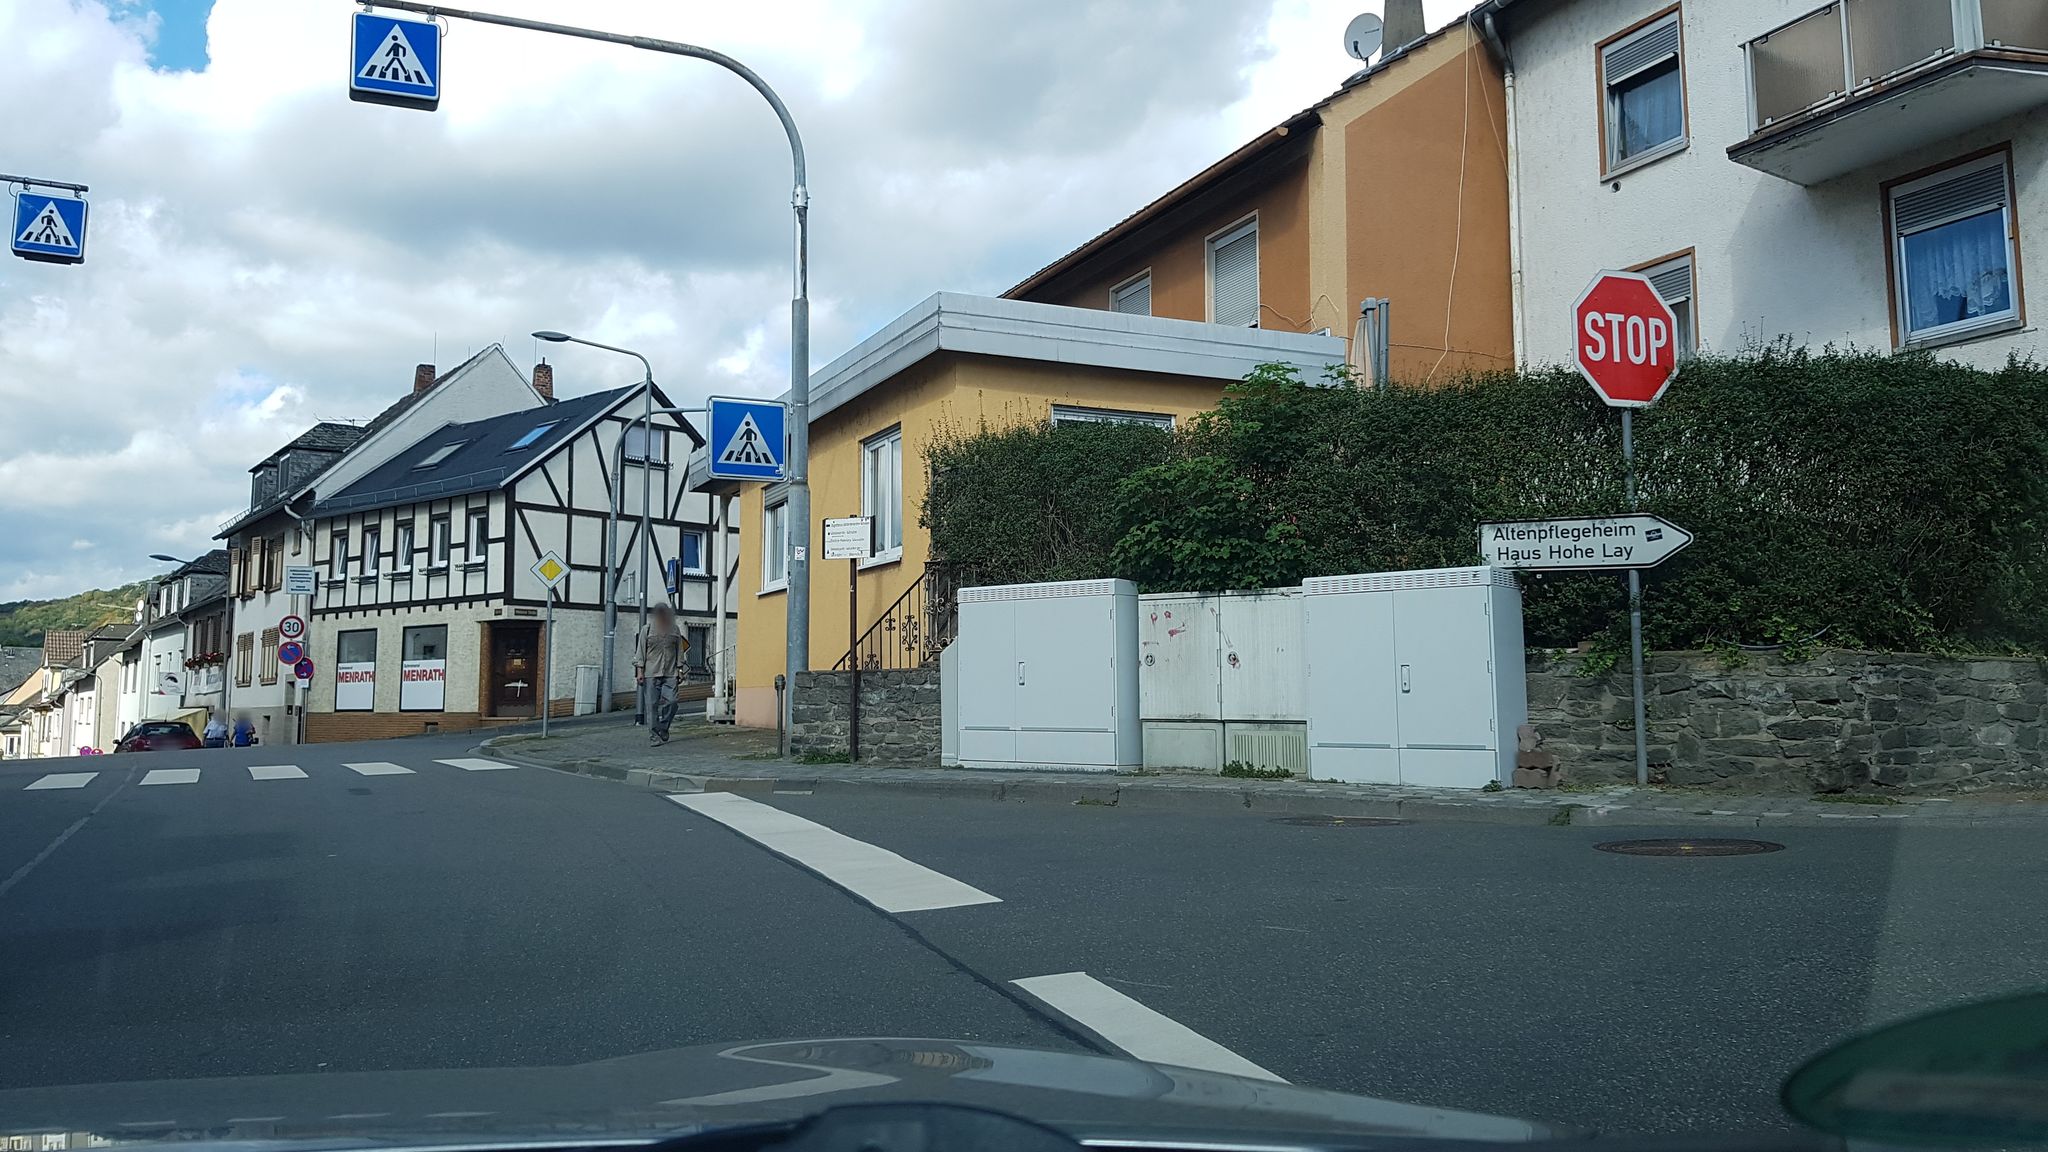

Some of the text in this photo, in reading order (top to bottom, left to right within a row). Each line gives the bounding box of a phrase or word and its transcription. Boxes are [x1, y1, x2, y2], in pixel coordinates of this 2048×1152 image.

[1584, 311, 1667, 366] STOP
[1493, 523, 1636, 543] Altenpflegeheim
[1498, 543, 1634, 560] Haus Hohe Lay
[284, 622, 299, 633] 30
[338, 671, 375, 683] MENRATH
[403, 669, 444, 681] MENRATH
